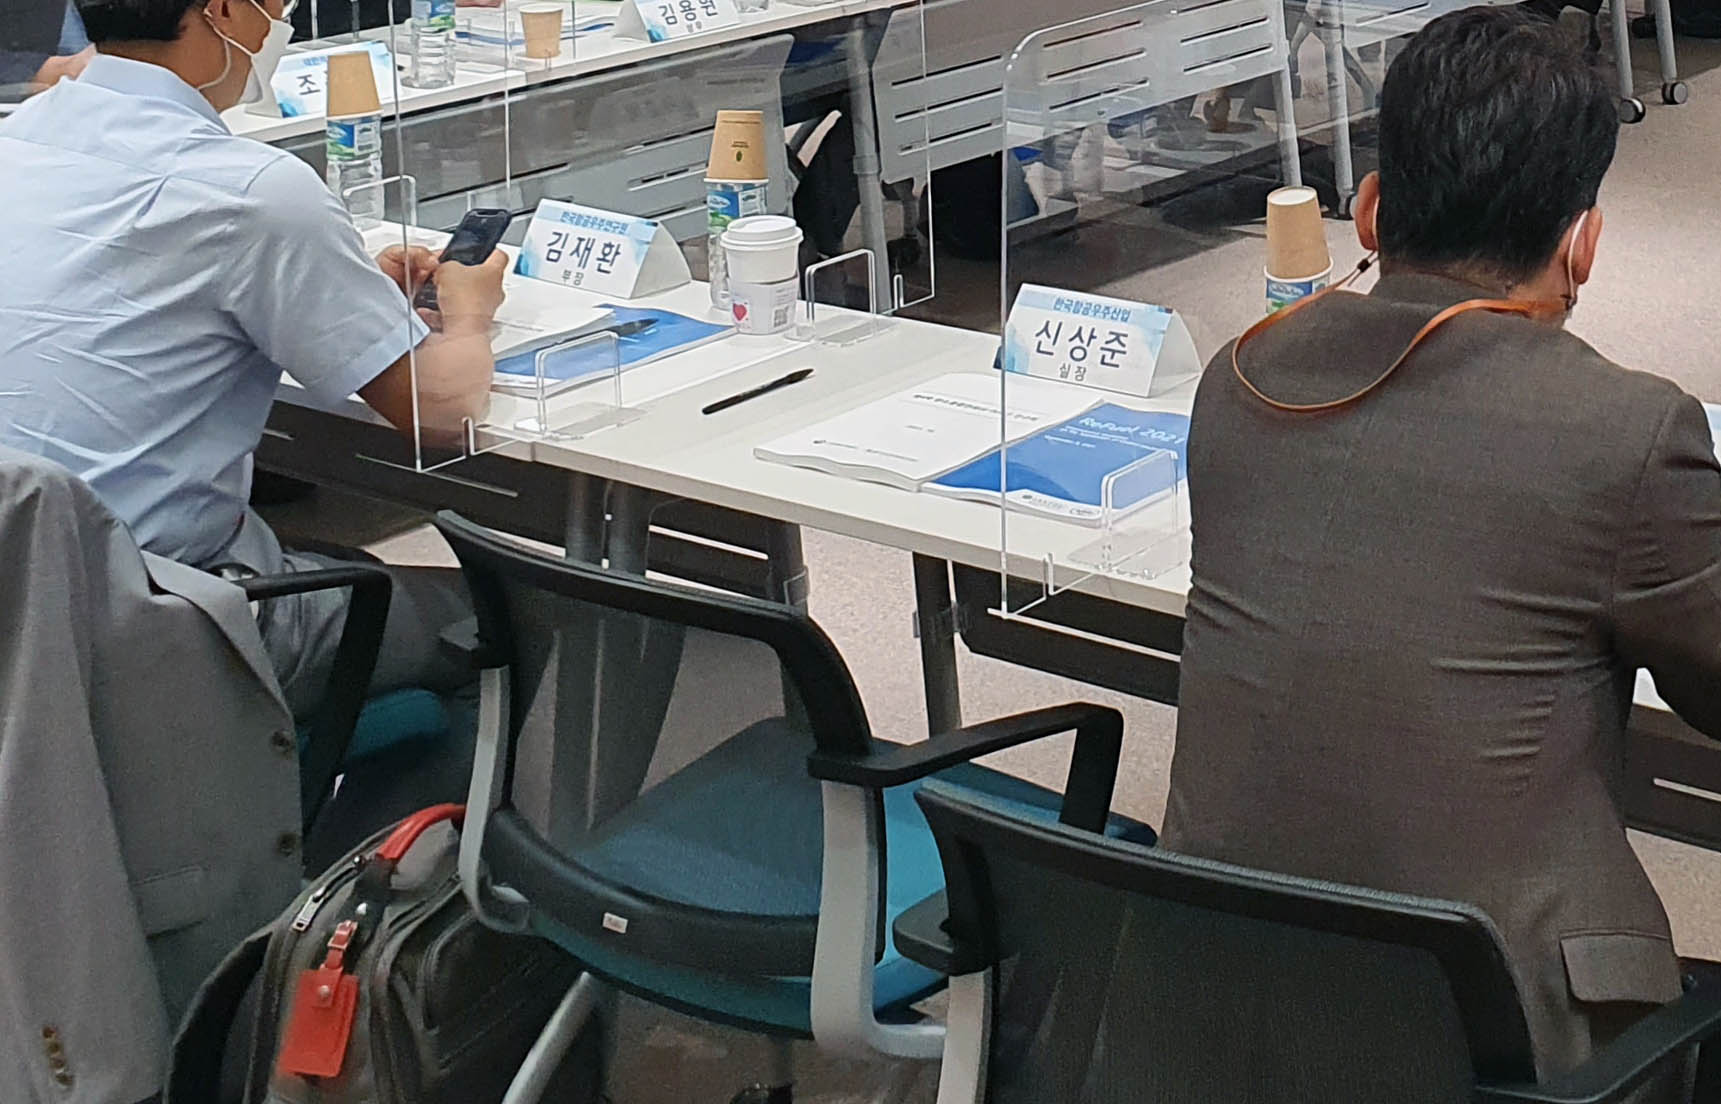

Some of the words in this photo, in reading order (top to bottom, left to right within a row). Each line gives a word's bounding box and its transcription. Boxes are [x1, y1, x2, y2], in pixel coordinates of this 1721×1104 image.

[545, 231, 621, 275] 김재환
[1053, 297, 1131, 323] 한국항공우주산업
[1034, 319, 1129, 369] 신상준
[1058, 362, 1087, 382] 실장
